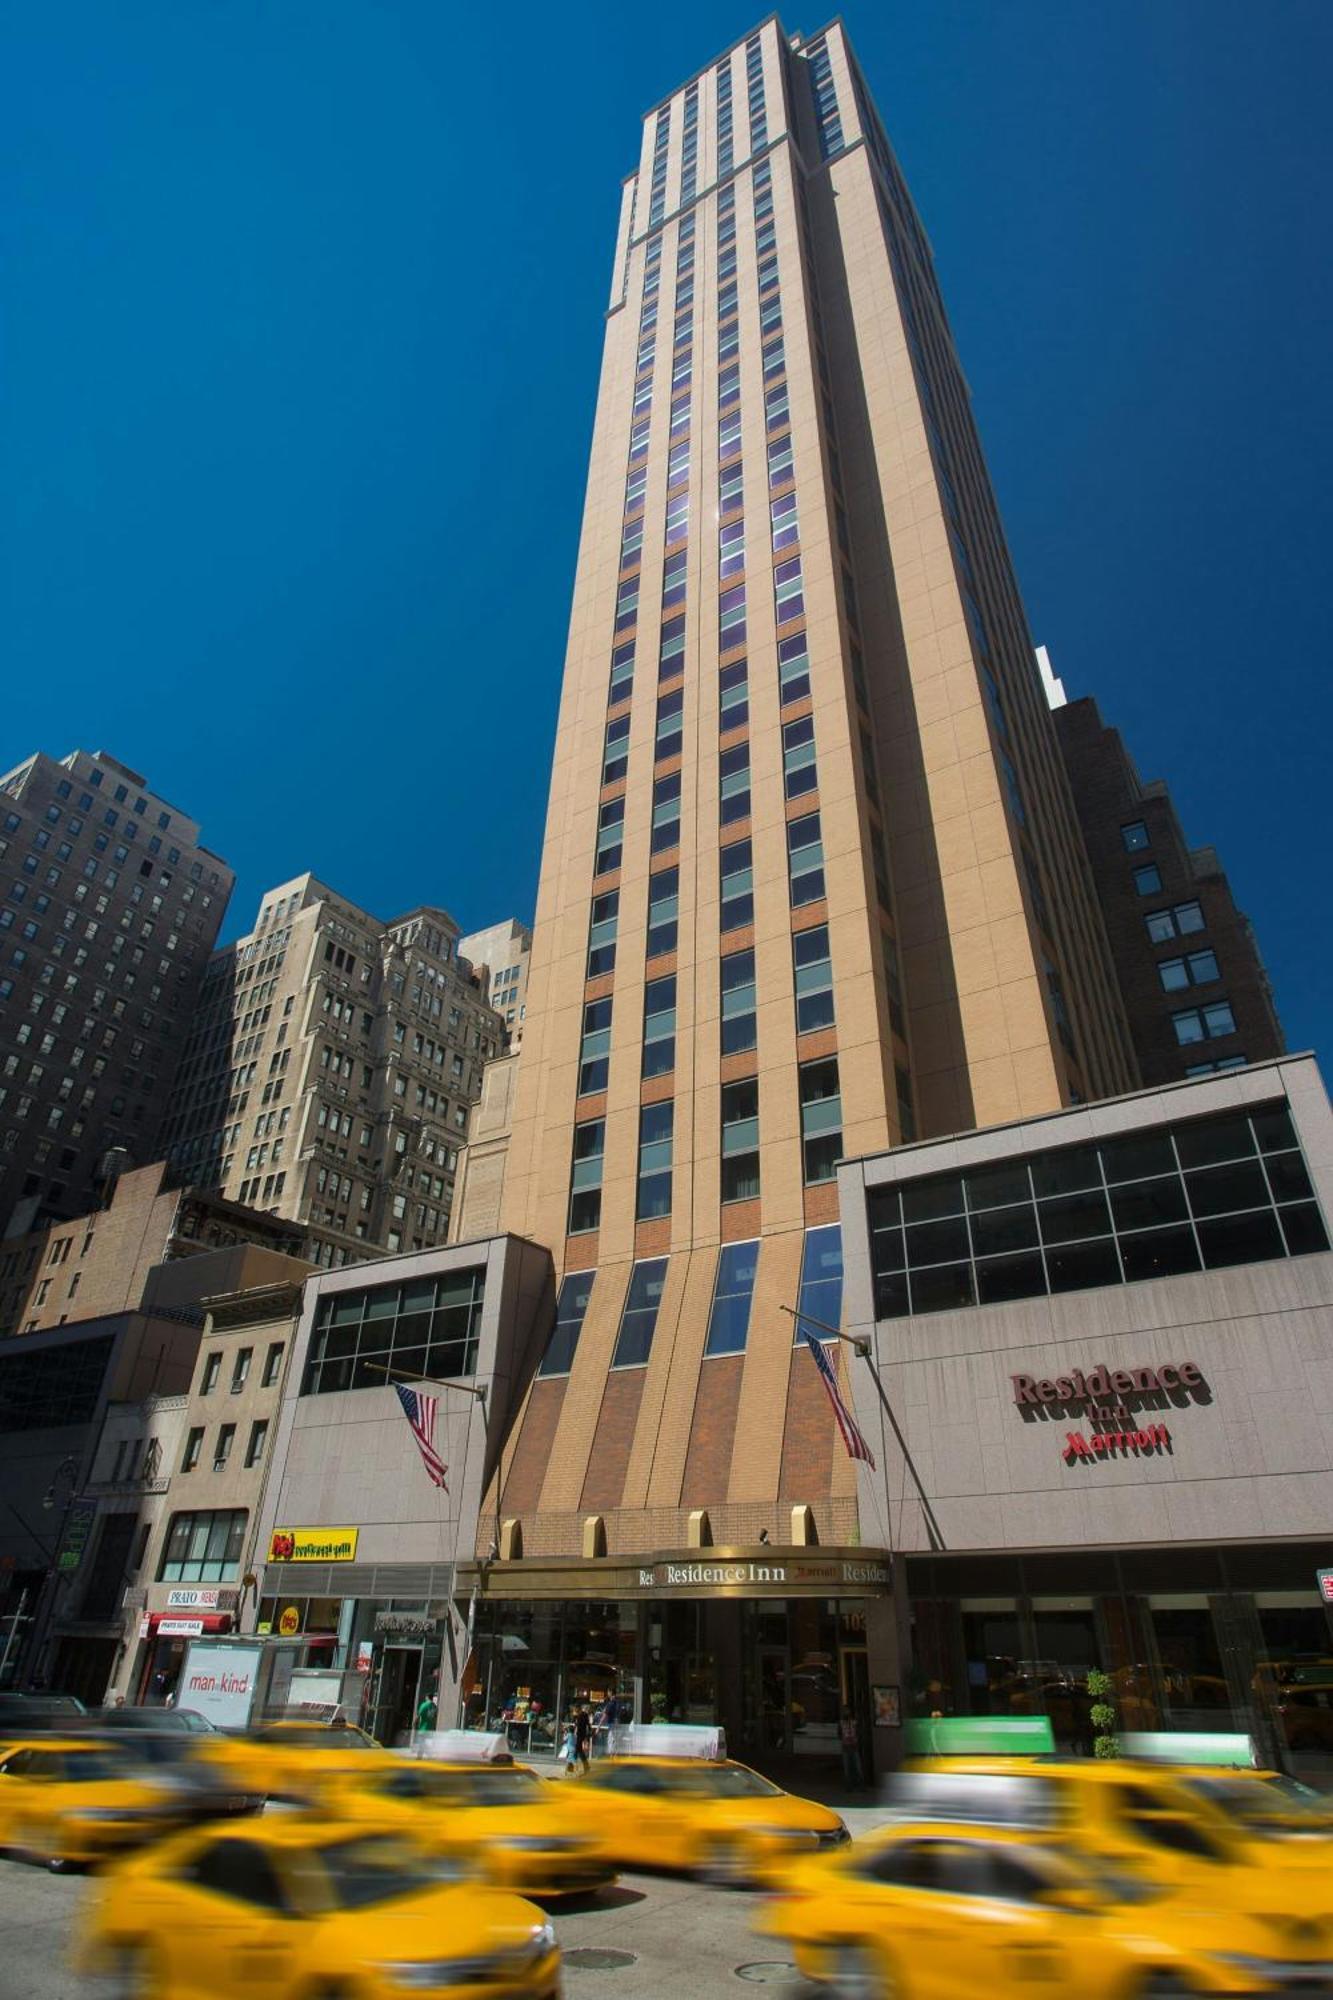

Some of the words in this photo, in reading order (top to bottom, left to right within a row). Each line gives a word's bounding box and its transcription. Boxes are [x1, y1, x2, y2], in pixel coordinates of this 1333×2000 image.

[1010, 1362, 1202, 1404] Residence
[1086, 1403, 1130, 1421] Inn
[1062, 1423, 1169, 1458] Marriott
[667, 1564, 745, 1584] Residence
[749, 1563, 786, 1581] Inn
[170, 1591, 198, 1604] PRATO
[189, 1674, 216, 1691] man
[220, 1672, 249, 1694] kind
